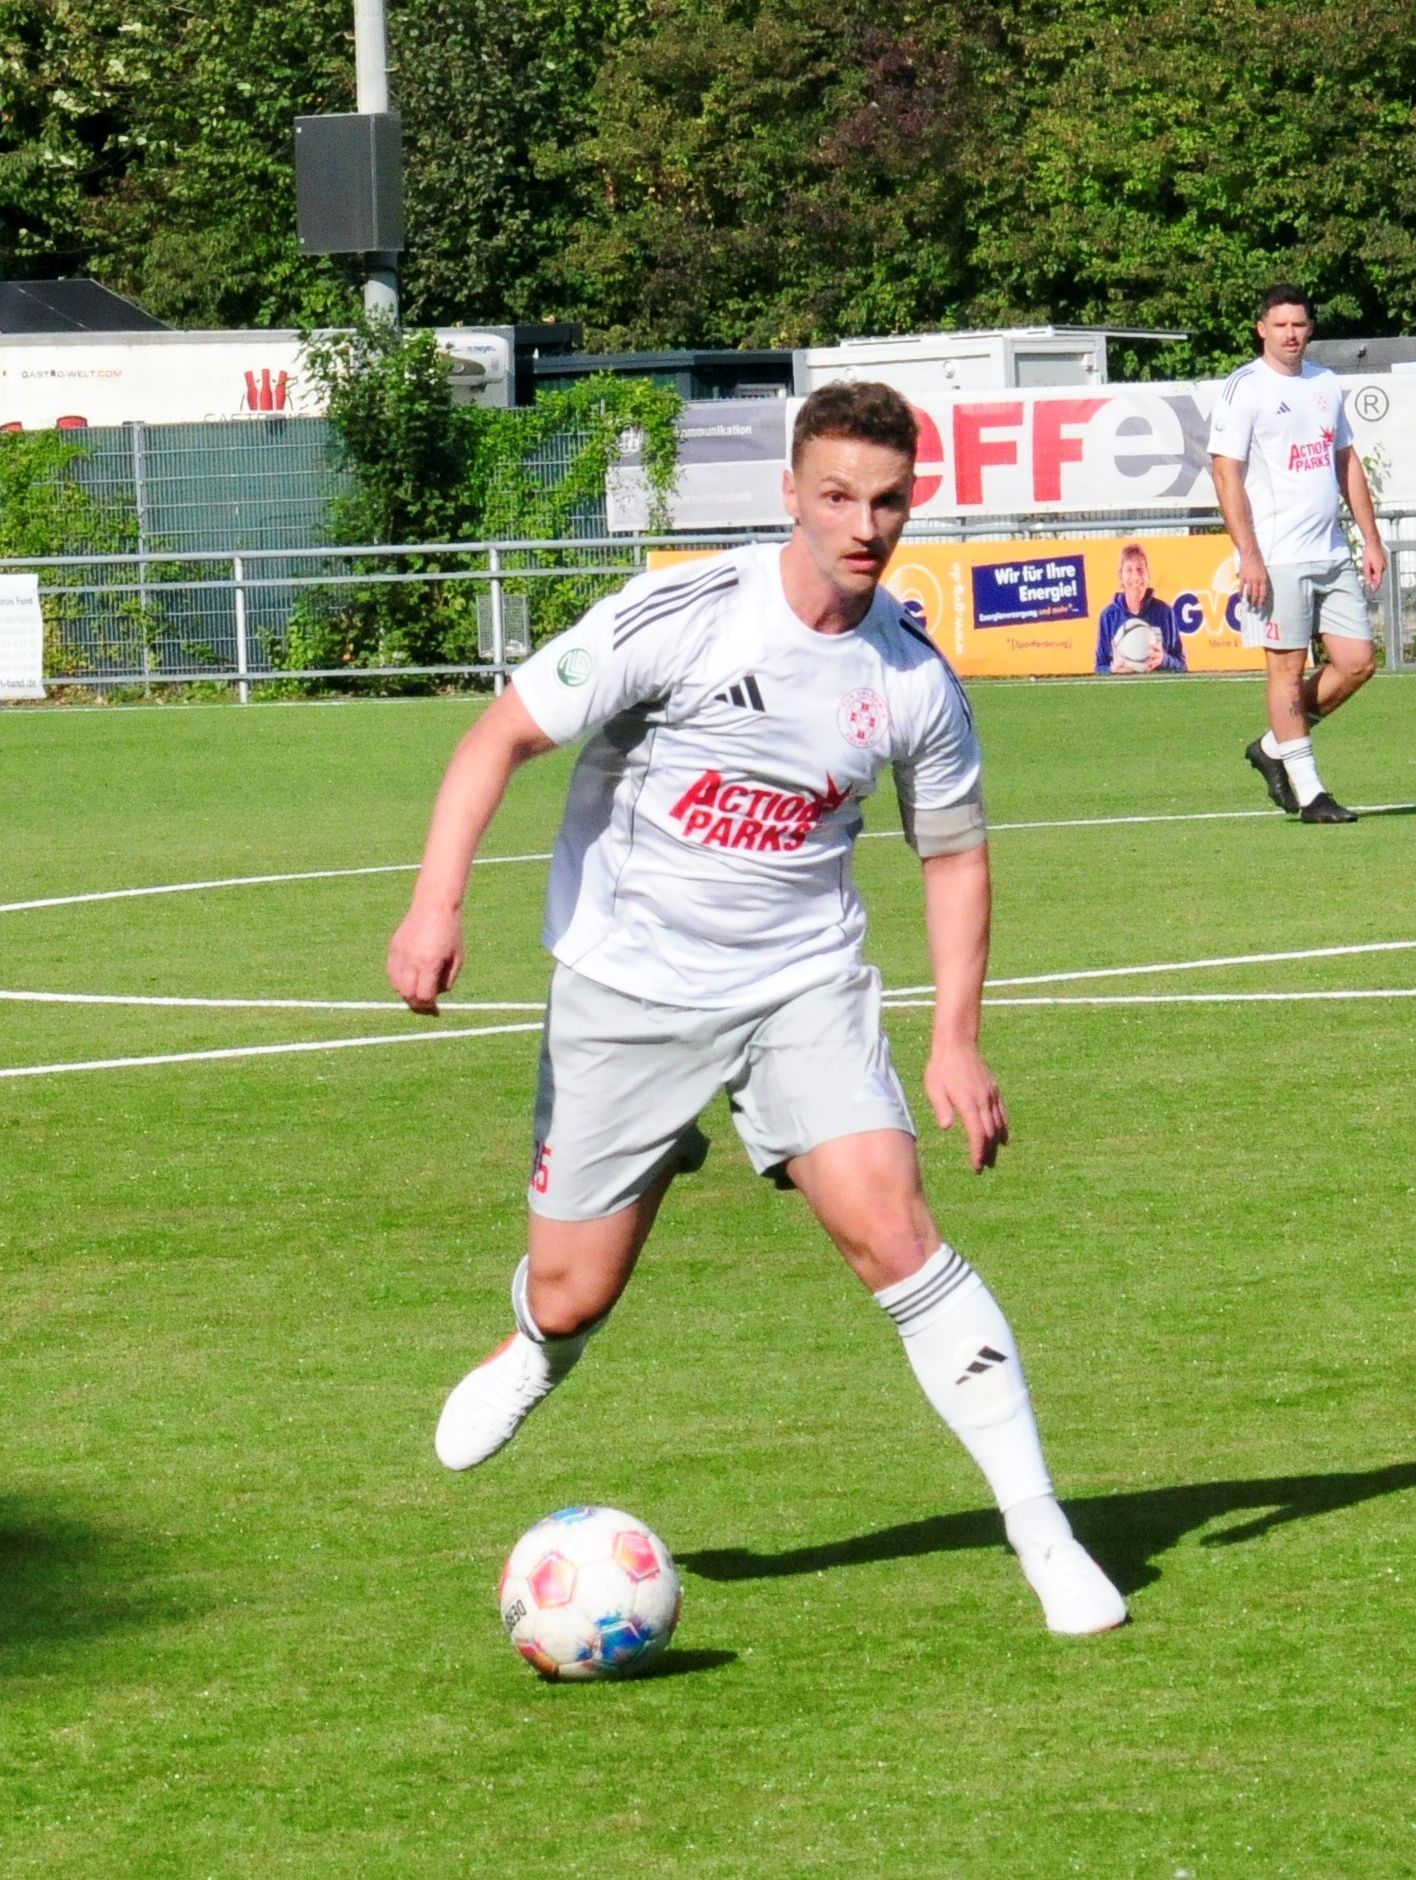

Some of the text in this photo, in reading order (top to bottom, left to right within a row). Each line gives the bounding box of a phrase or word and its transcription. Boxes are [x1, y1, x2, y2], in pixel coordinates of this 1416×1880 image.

[679, 424, 752, 438] ommunikation
[1295, 453, 1331, 472] PARKS
[994, 562, 1076, 585] Wir für Ihre
[1018, 581, 1077, 602] Energie!
[1038, 607, 1052, 616] und
[1265, 621, 1280, 640] 21
[682, 808, 816, 852] PARKS
